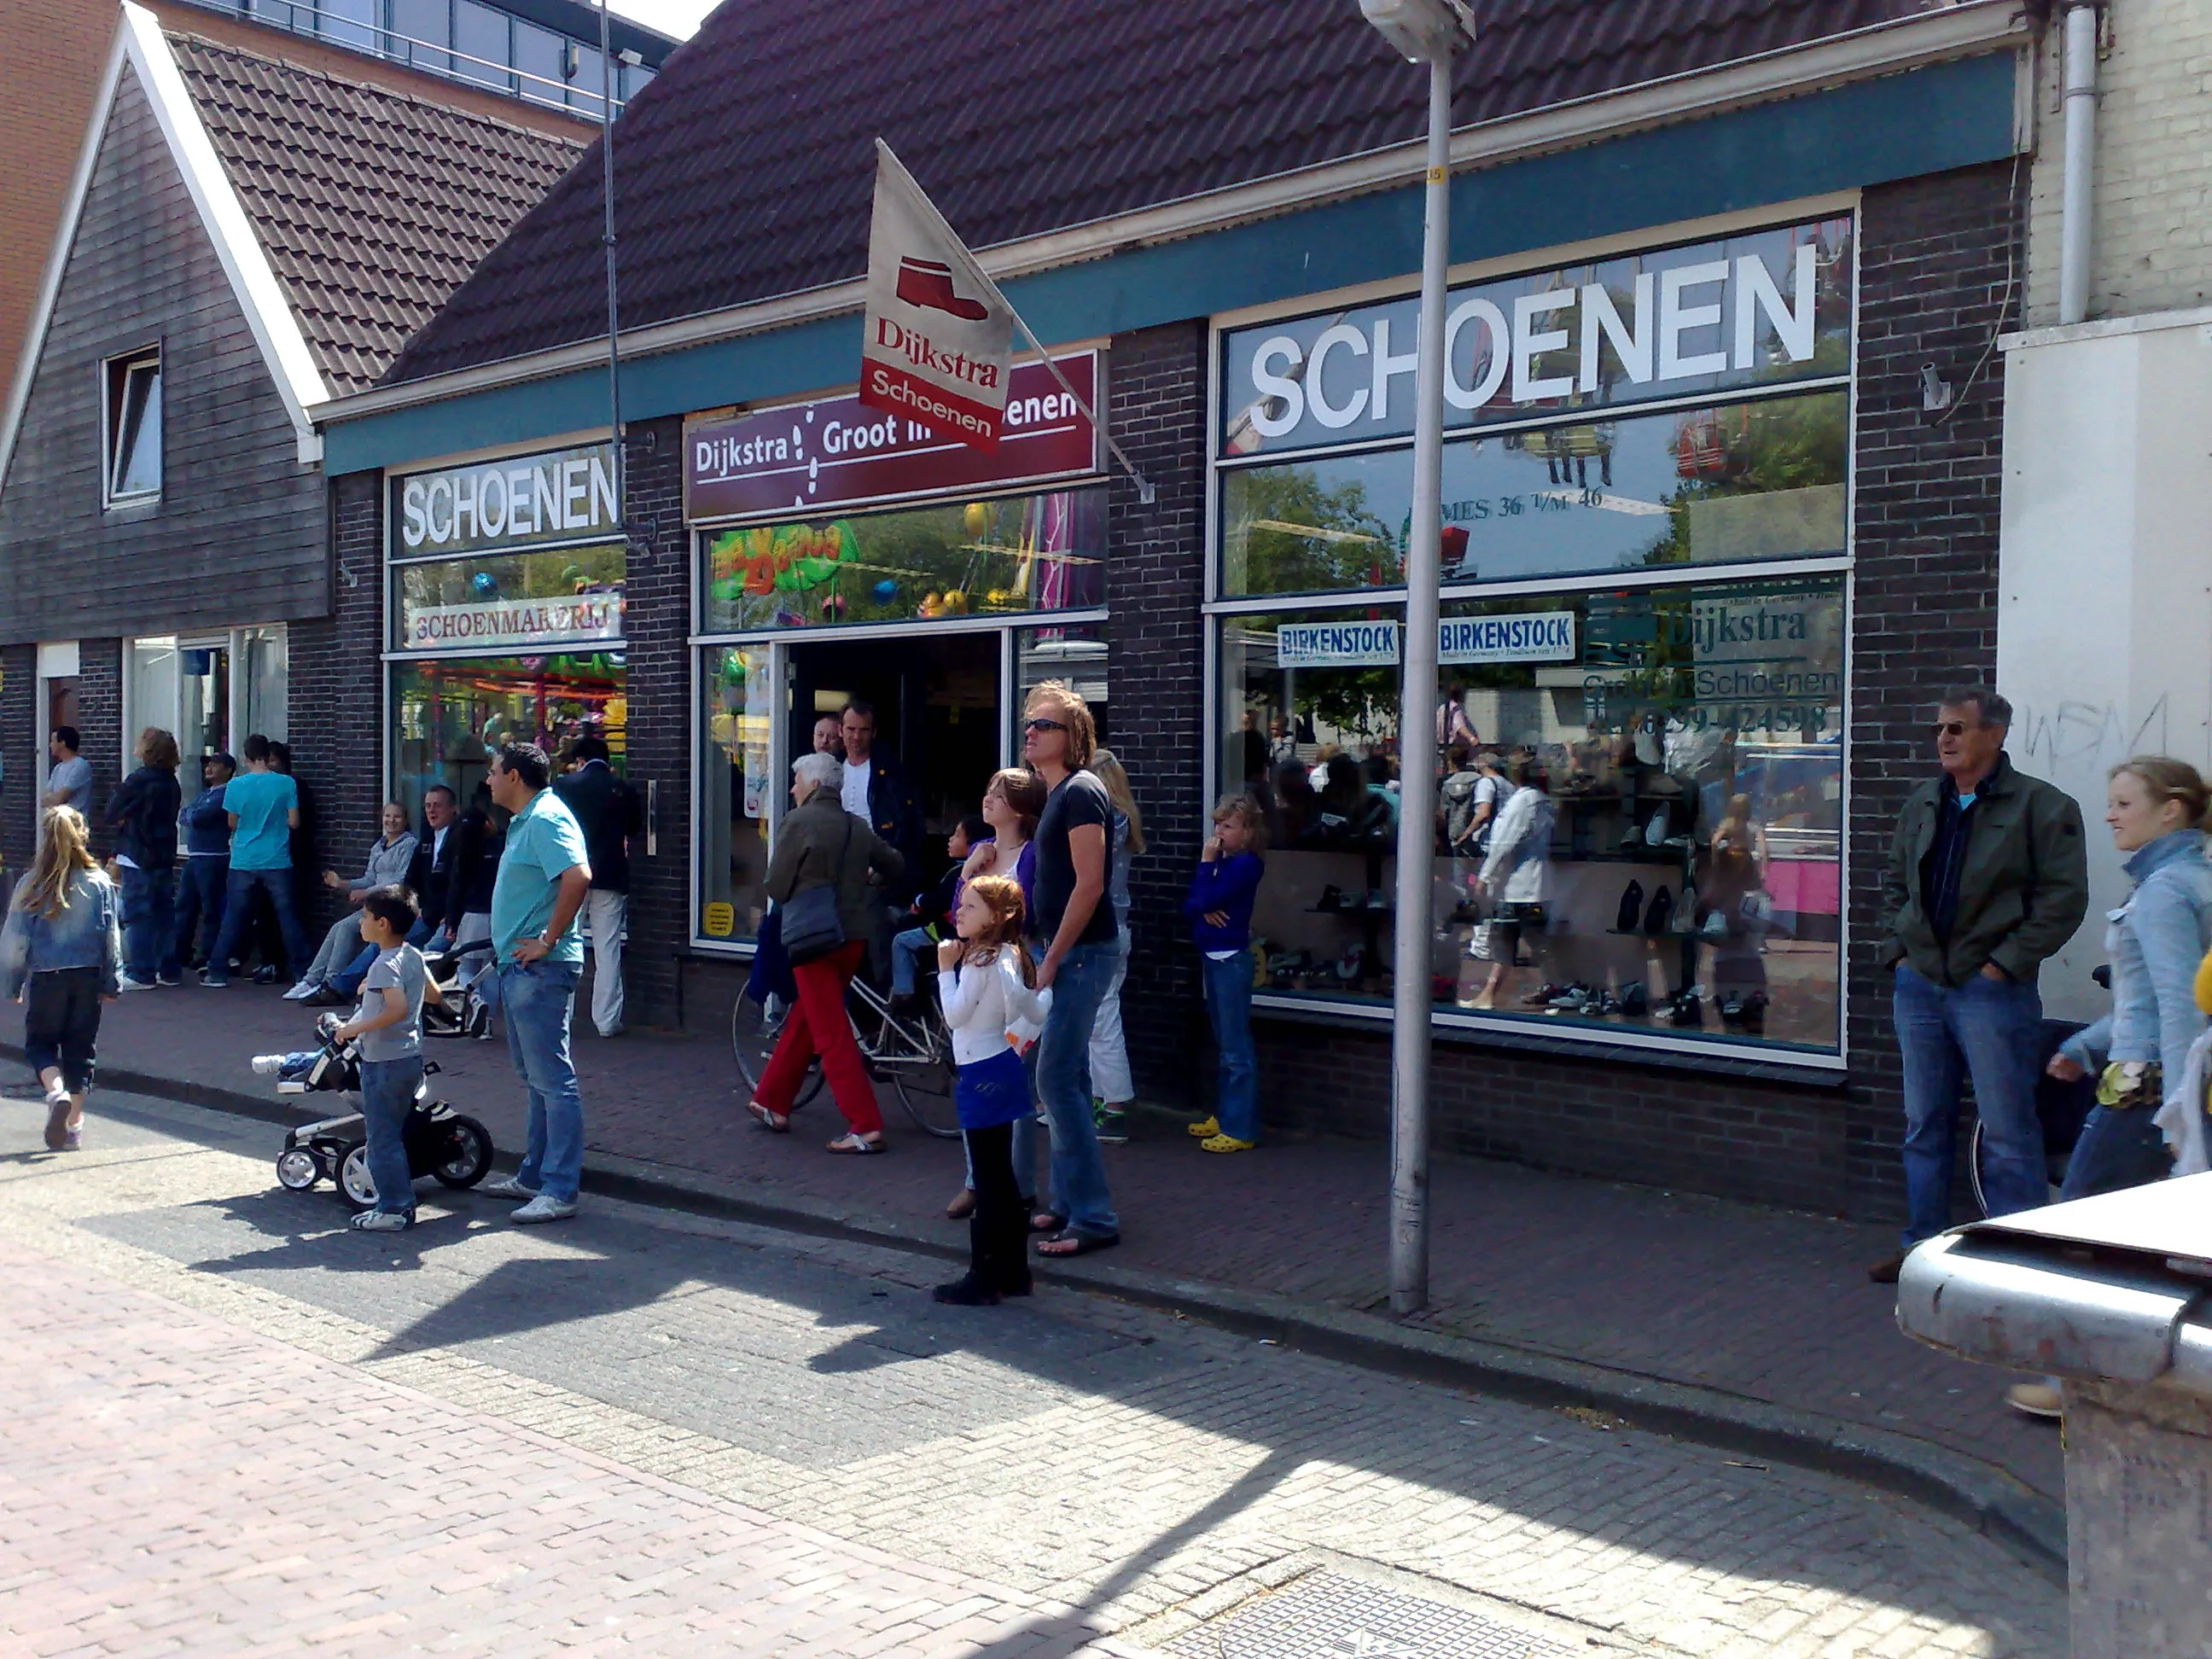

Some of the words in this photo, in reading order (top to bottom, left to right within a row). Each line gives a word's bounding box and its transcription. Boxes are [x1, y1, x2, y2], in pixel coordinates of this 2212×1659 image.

[876, 317, 998, 389] Dijkstra
[1249, 244, 1817, 437] SCHOENEN
[871, 370, 992, 438] Schoenen
[696, 434, 788, 477] Dijkstra
[823, 414, 897, 454] Groot
[402, 455, 619, 546] SCHOENEN
[1498, 494, 1524, 517] 36
[1578, 485, 1606, 509] 46
[416, 602, 609, 640] SCHOENMAKERIJ
[1282, 626, 1395, 655] BIRKENSTOCK
[1440, 617, 1570, 651] BIRKENSTOCK
[1668, 607, 1807, 655] Dijkstra
[1697, 669, 1840, 696] Schoenen
